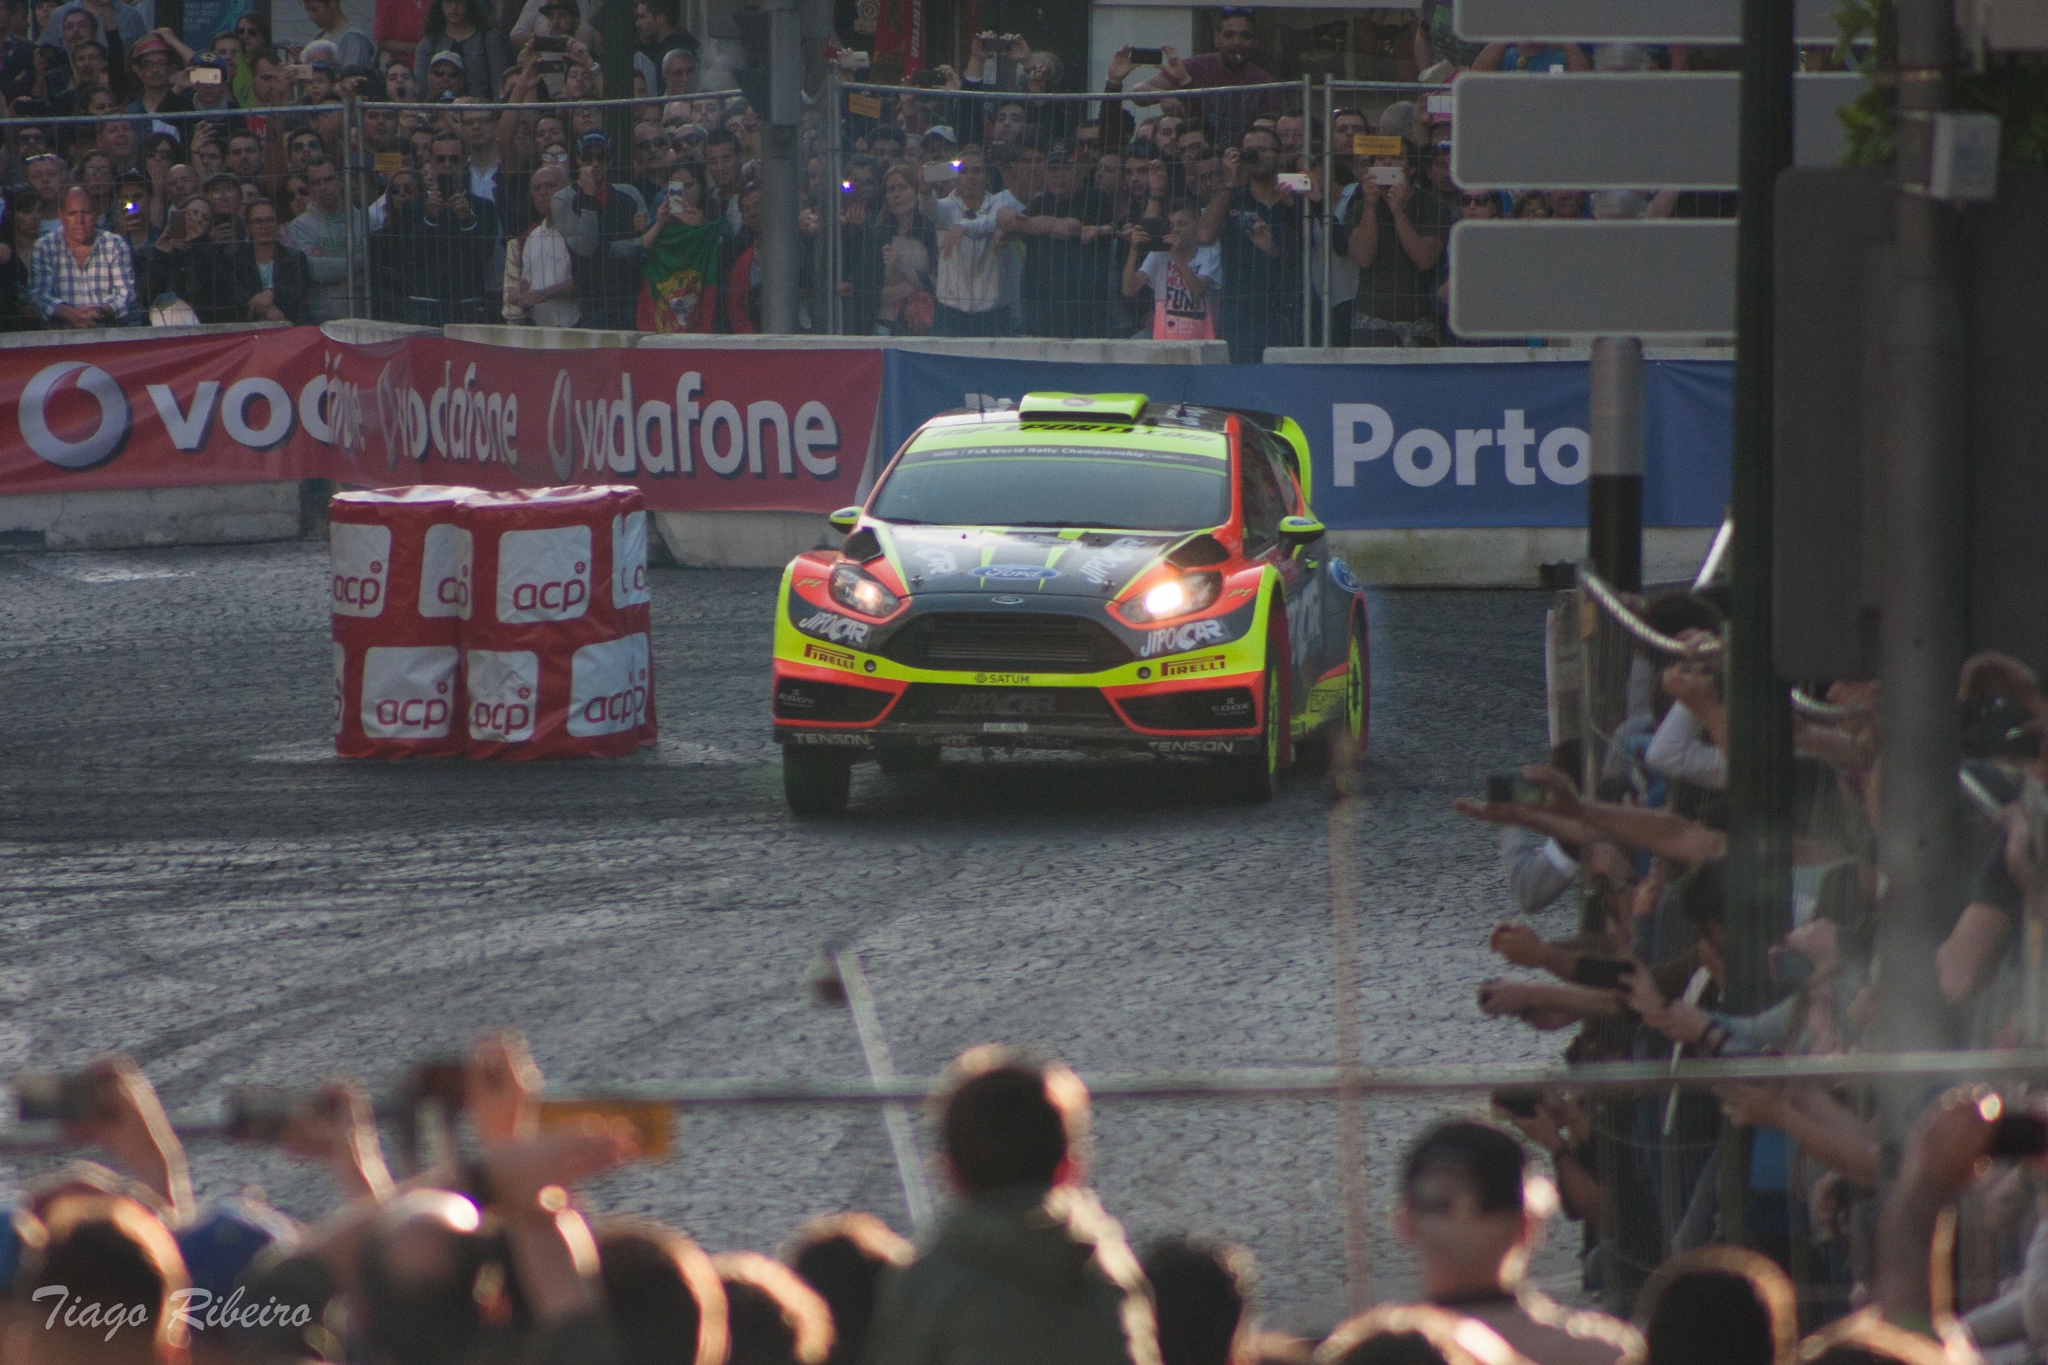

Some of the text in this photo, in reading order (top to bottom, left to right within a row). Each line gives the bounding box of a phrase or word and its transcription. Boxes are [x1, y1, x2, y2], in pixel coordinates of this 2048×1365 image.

[576, 371, 837, 475] vodafone
[1332, 403, 1591, 487] Porto
[984, 566, 1042, 578] Ford
[512, 579, 586, 612] acp
[804, 643, 856, 669] PIRELLI
[1160, 654, 1226, 677] PIRELLI
[989, 674, 1029, 684] SATUM
[376, 699, 448, 730] acp
[474, 702, 530, 735] acp
[793, 732, 870, 745] TENSON
[1148, 741, 1234, 753] TENSON
